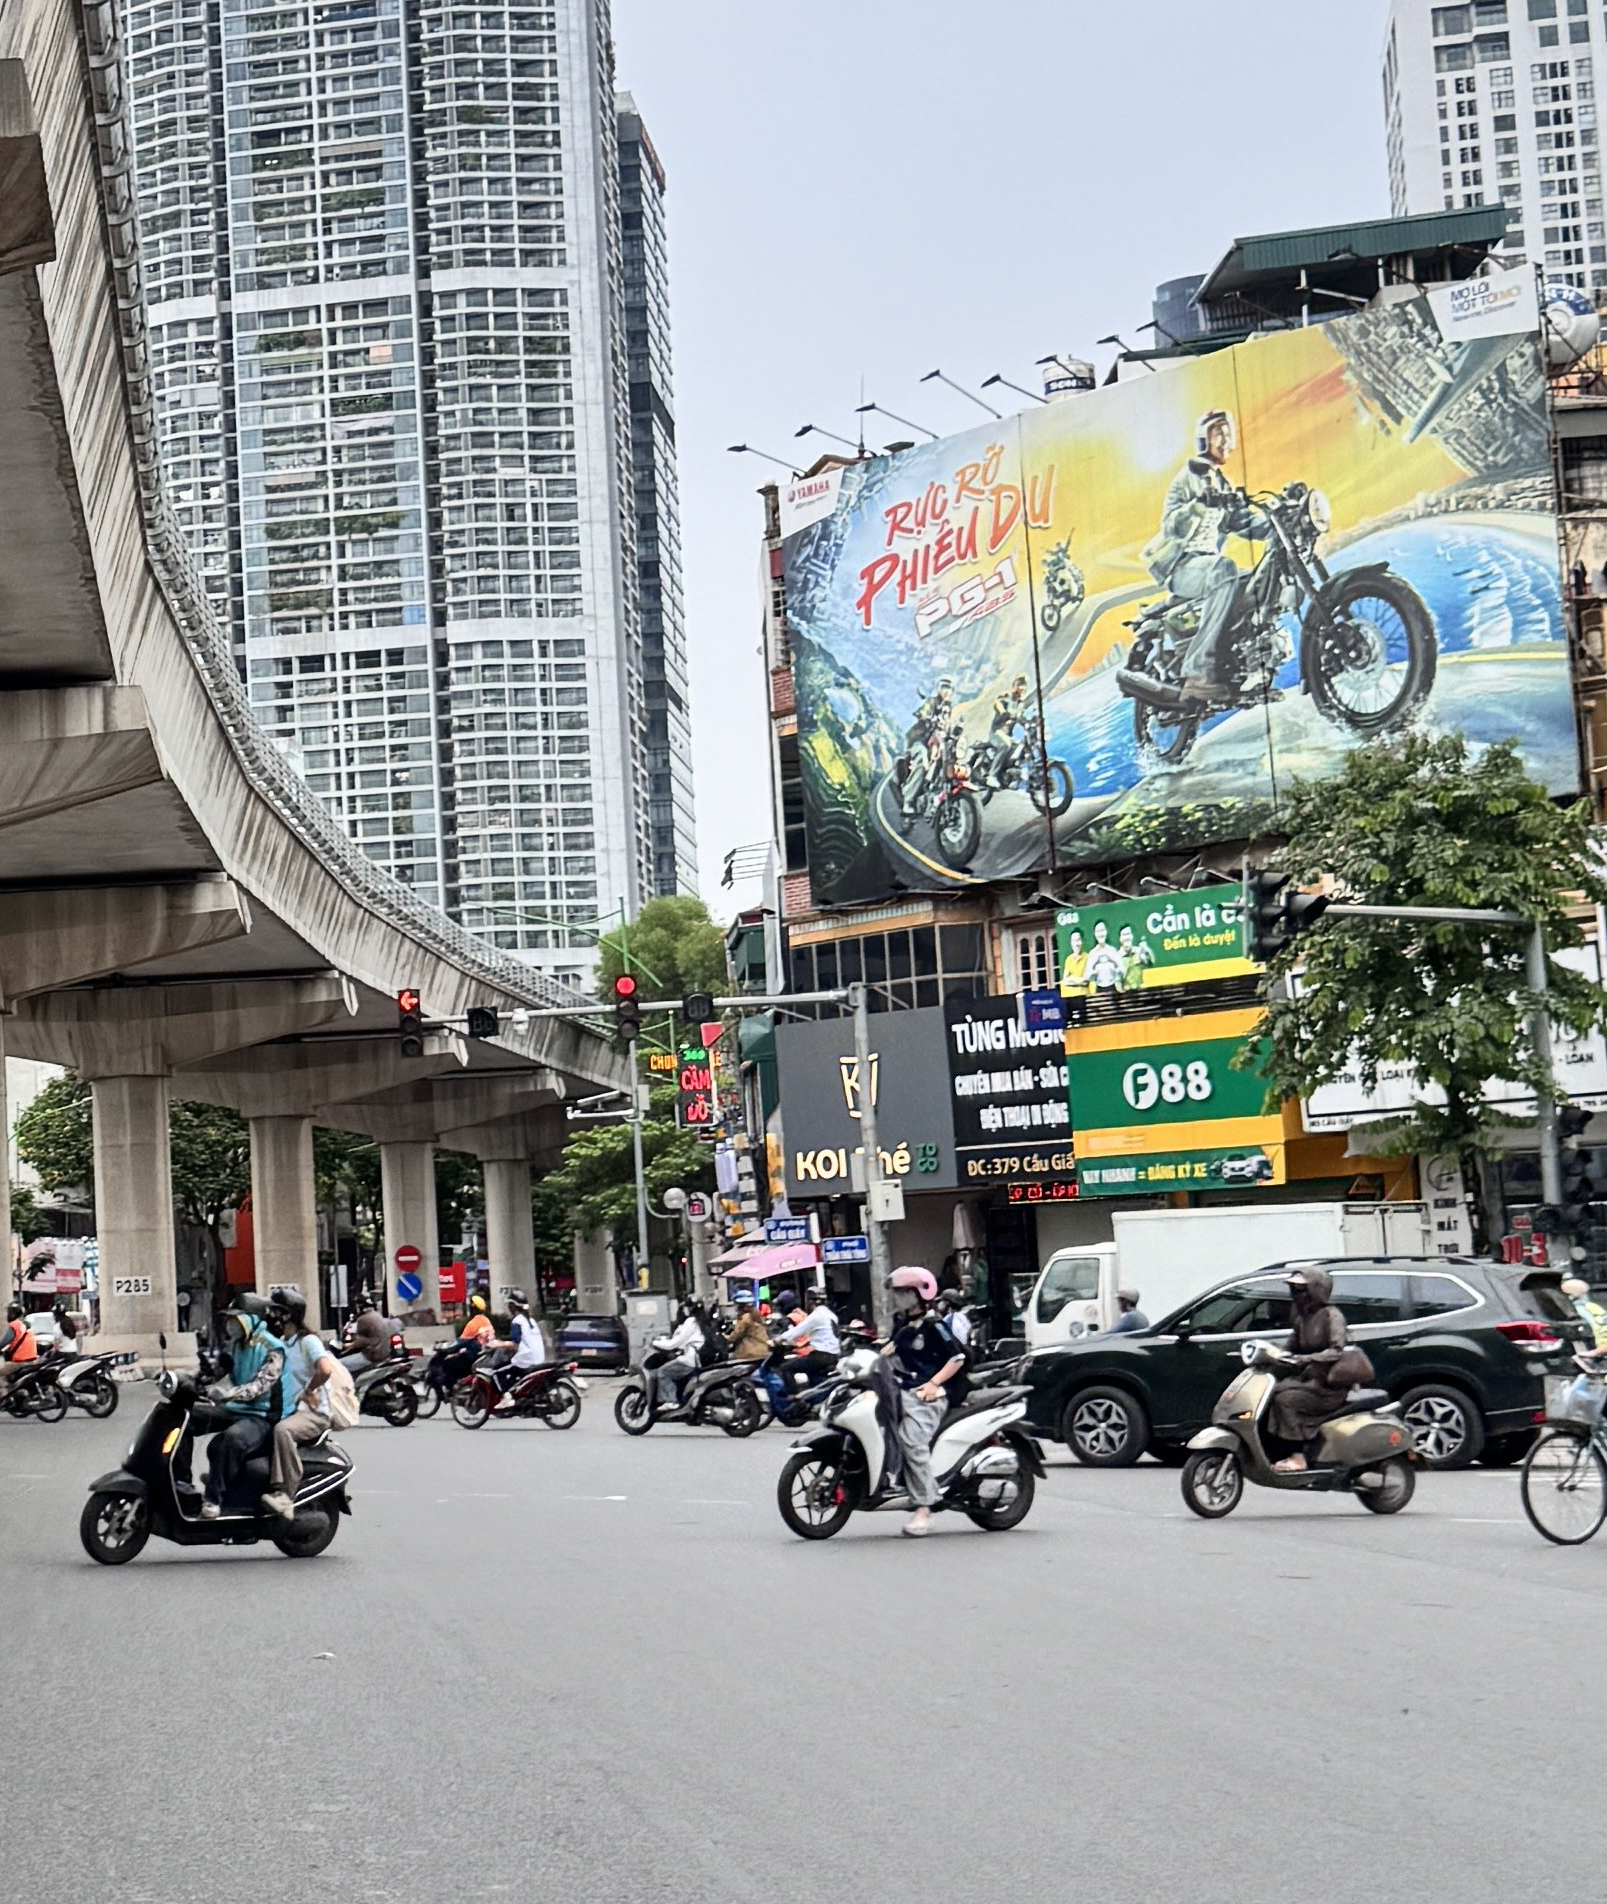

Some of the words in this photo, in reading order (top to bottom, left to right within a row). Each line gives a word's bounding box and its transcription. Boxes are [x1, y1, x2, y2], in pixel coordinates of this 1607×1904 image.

[797, 479, 830, 499] YAMAHA
[884, 481, 949, 546] RỰC
[954, 442, 1005, 504] RỠ
[855, 506, 980, 628] PHIÊU
[987, 463, 1055, 552] DU
[915, 555, 1018, 640] PG-1
[1146, 904, 1190, 935] Cần
[1195, 903, 1216, 929] là
[1163, 936, 1187, 952] Đến
[1188, 933, 1202, 948] là
[951, 1014, 1007, 1054] TÙNG
[1122, 1060, 1213, 1110] F88
[796, 1148, 848, 1181] KOI
[916, 1142, 938, 1157] TO
[967, 1157, 1021, 1177] ĐC:379
[1022, 1152, 1050, 1172] Cầu
[1050, 1151, 1076, 1171] Giấ
[115, 1278, 150, 1293] P285
